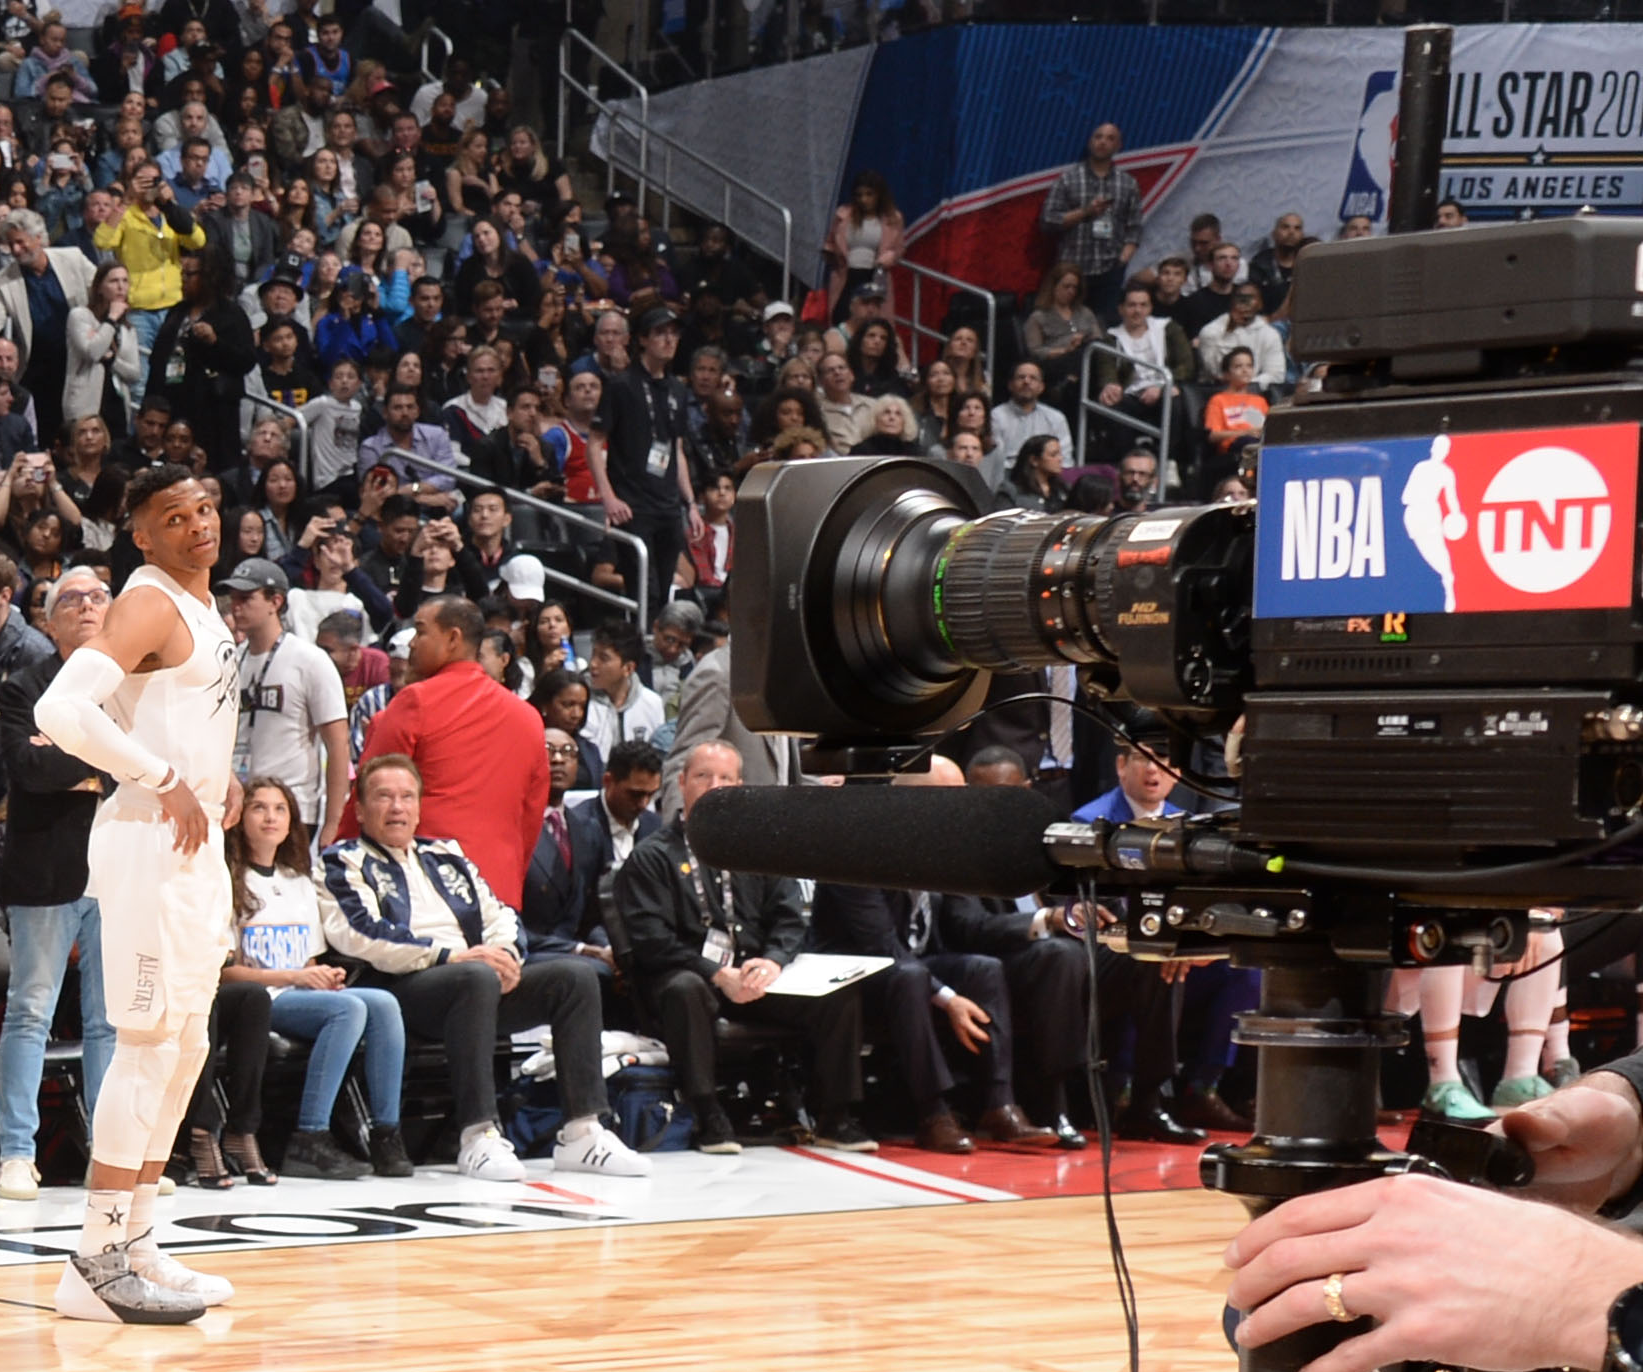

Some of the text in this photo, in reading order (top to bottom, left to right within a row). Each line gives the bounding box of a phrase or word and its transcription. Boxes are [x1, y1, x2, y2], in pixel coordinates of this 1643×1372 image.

[1443, 70, 1643, 138] LL STAR 20
[1445, 175, 1624, 200] LOS ANGELES
[1281, 476, 1386, 580] NBA
[1481, 496, 1613, 553] TNT
[128, 952, 160, 1013] ALL-STAR
